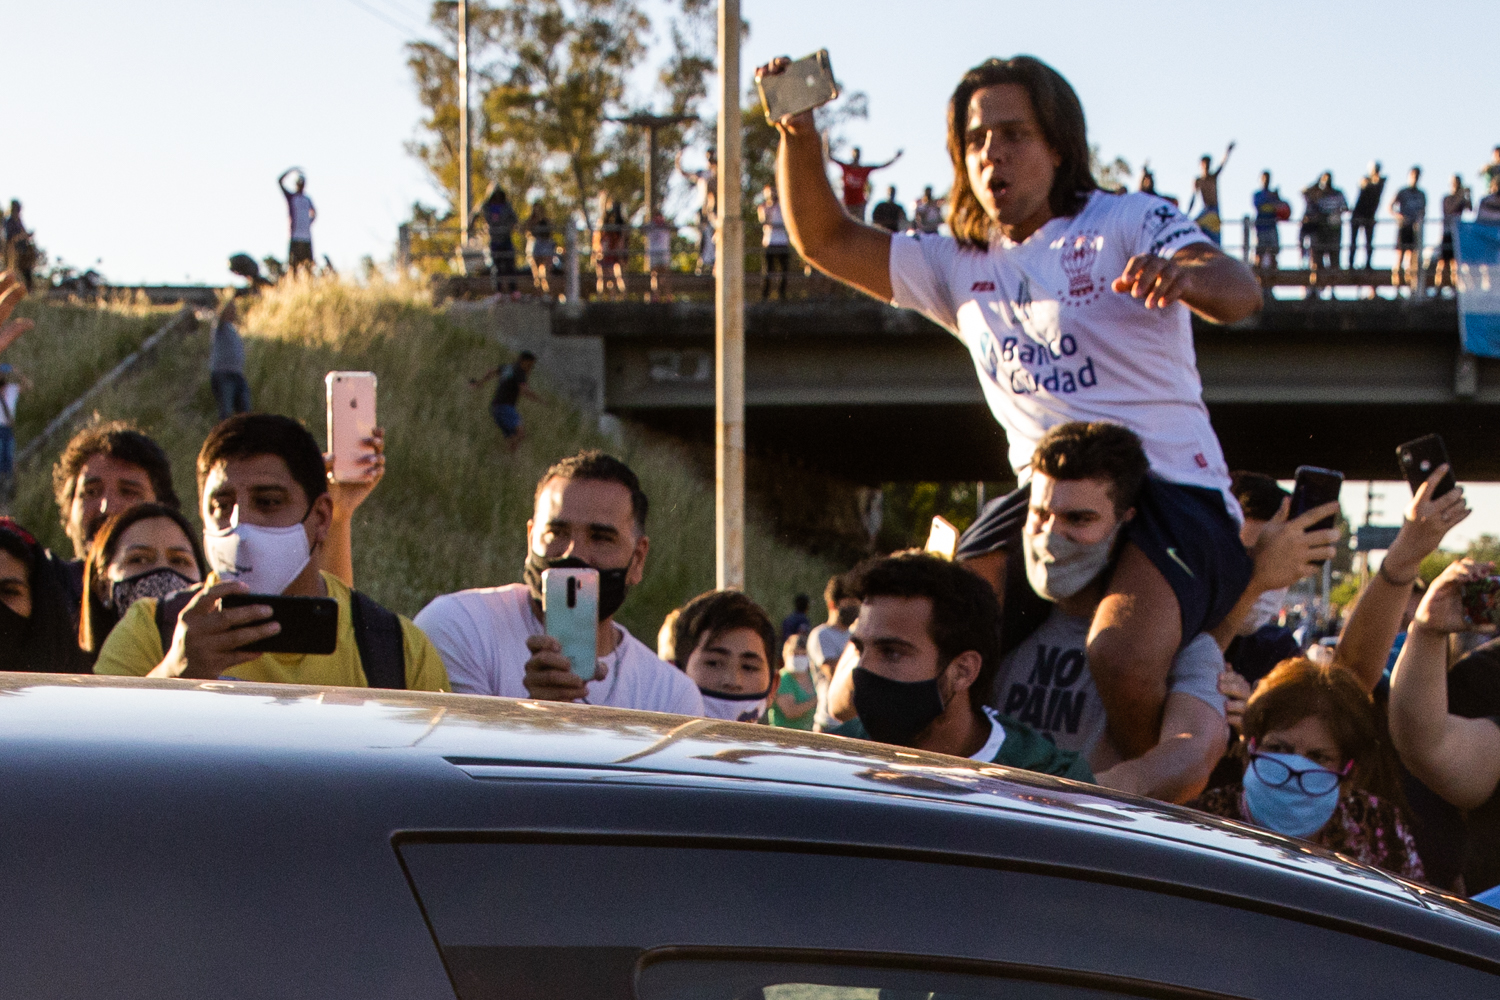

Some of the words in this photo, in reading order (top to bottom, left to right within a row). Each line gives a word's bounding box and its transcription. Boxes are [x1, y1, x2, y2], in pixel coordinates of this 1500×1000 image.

[1003, 333, 1078, 366] Banco
[1027, 643, 1086, 688] NO
[1004, 682, 1088, 734] PAIN
